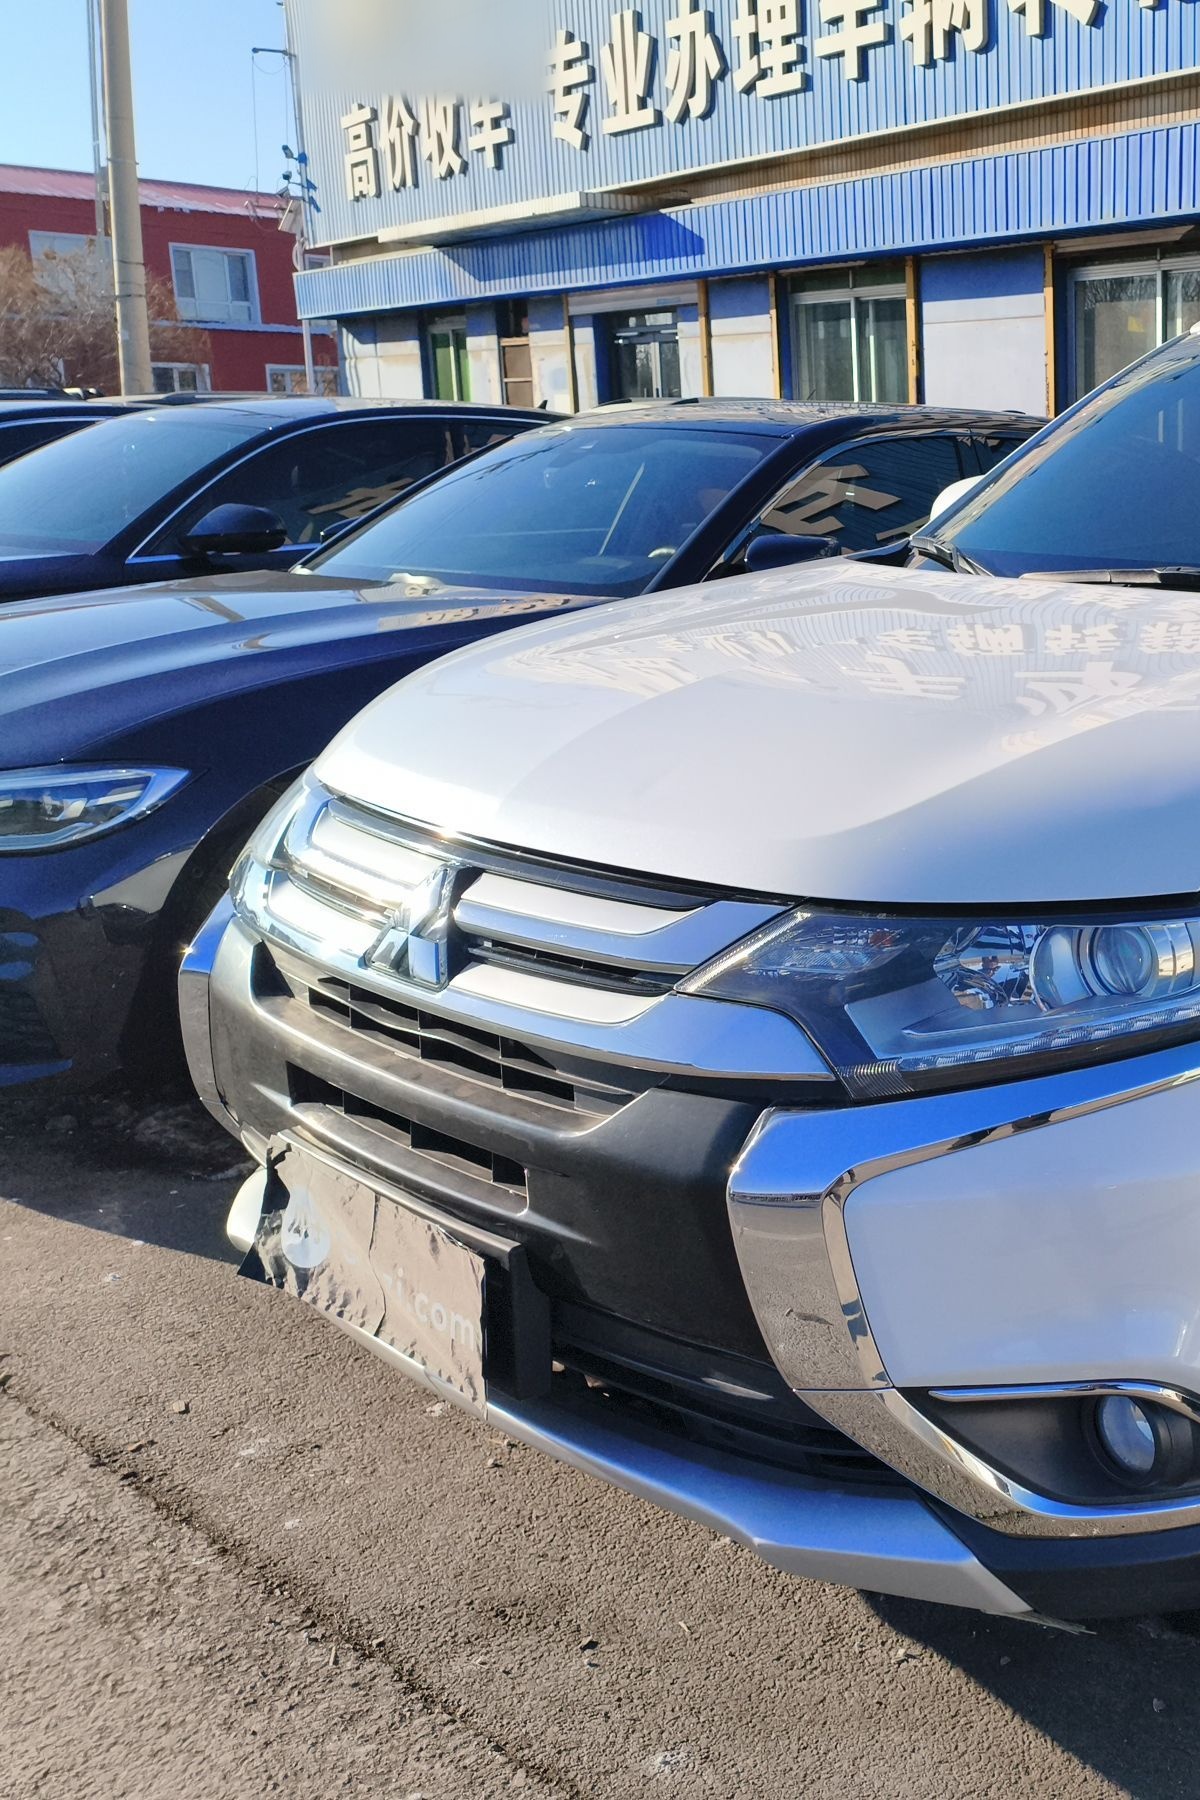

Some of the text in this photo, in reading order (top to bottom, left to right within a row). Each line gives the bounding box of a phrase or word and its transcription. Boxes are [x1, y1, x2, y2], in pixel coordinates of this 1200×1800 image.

[545, 0, 1200, 151] 专业办理车辆
[340, 94, 514, 202] 高价收车
